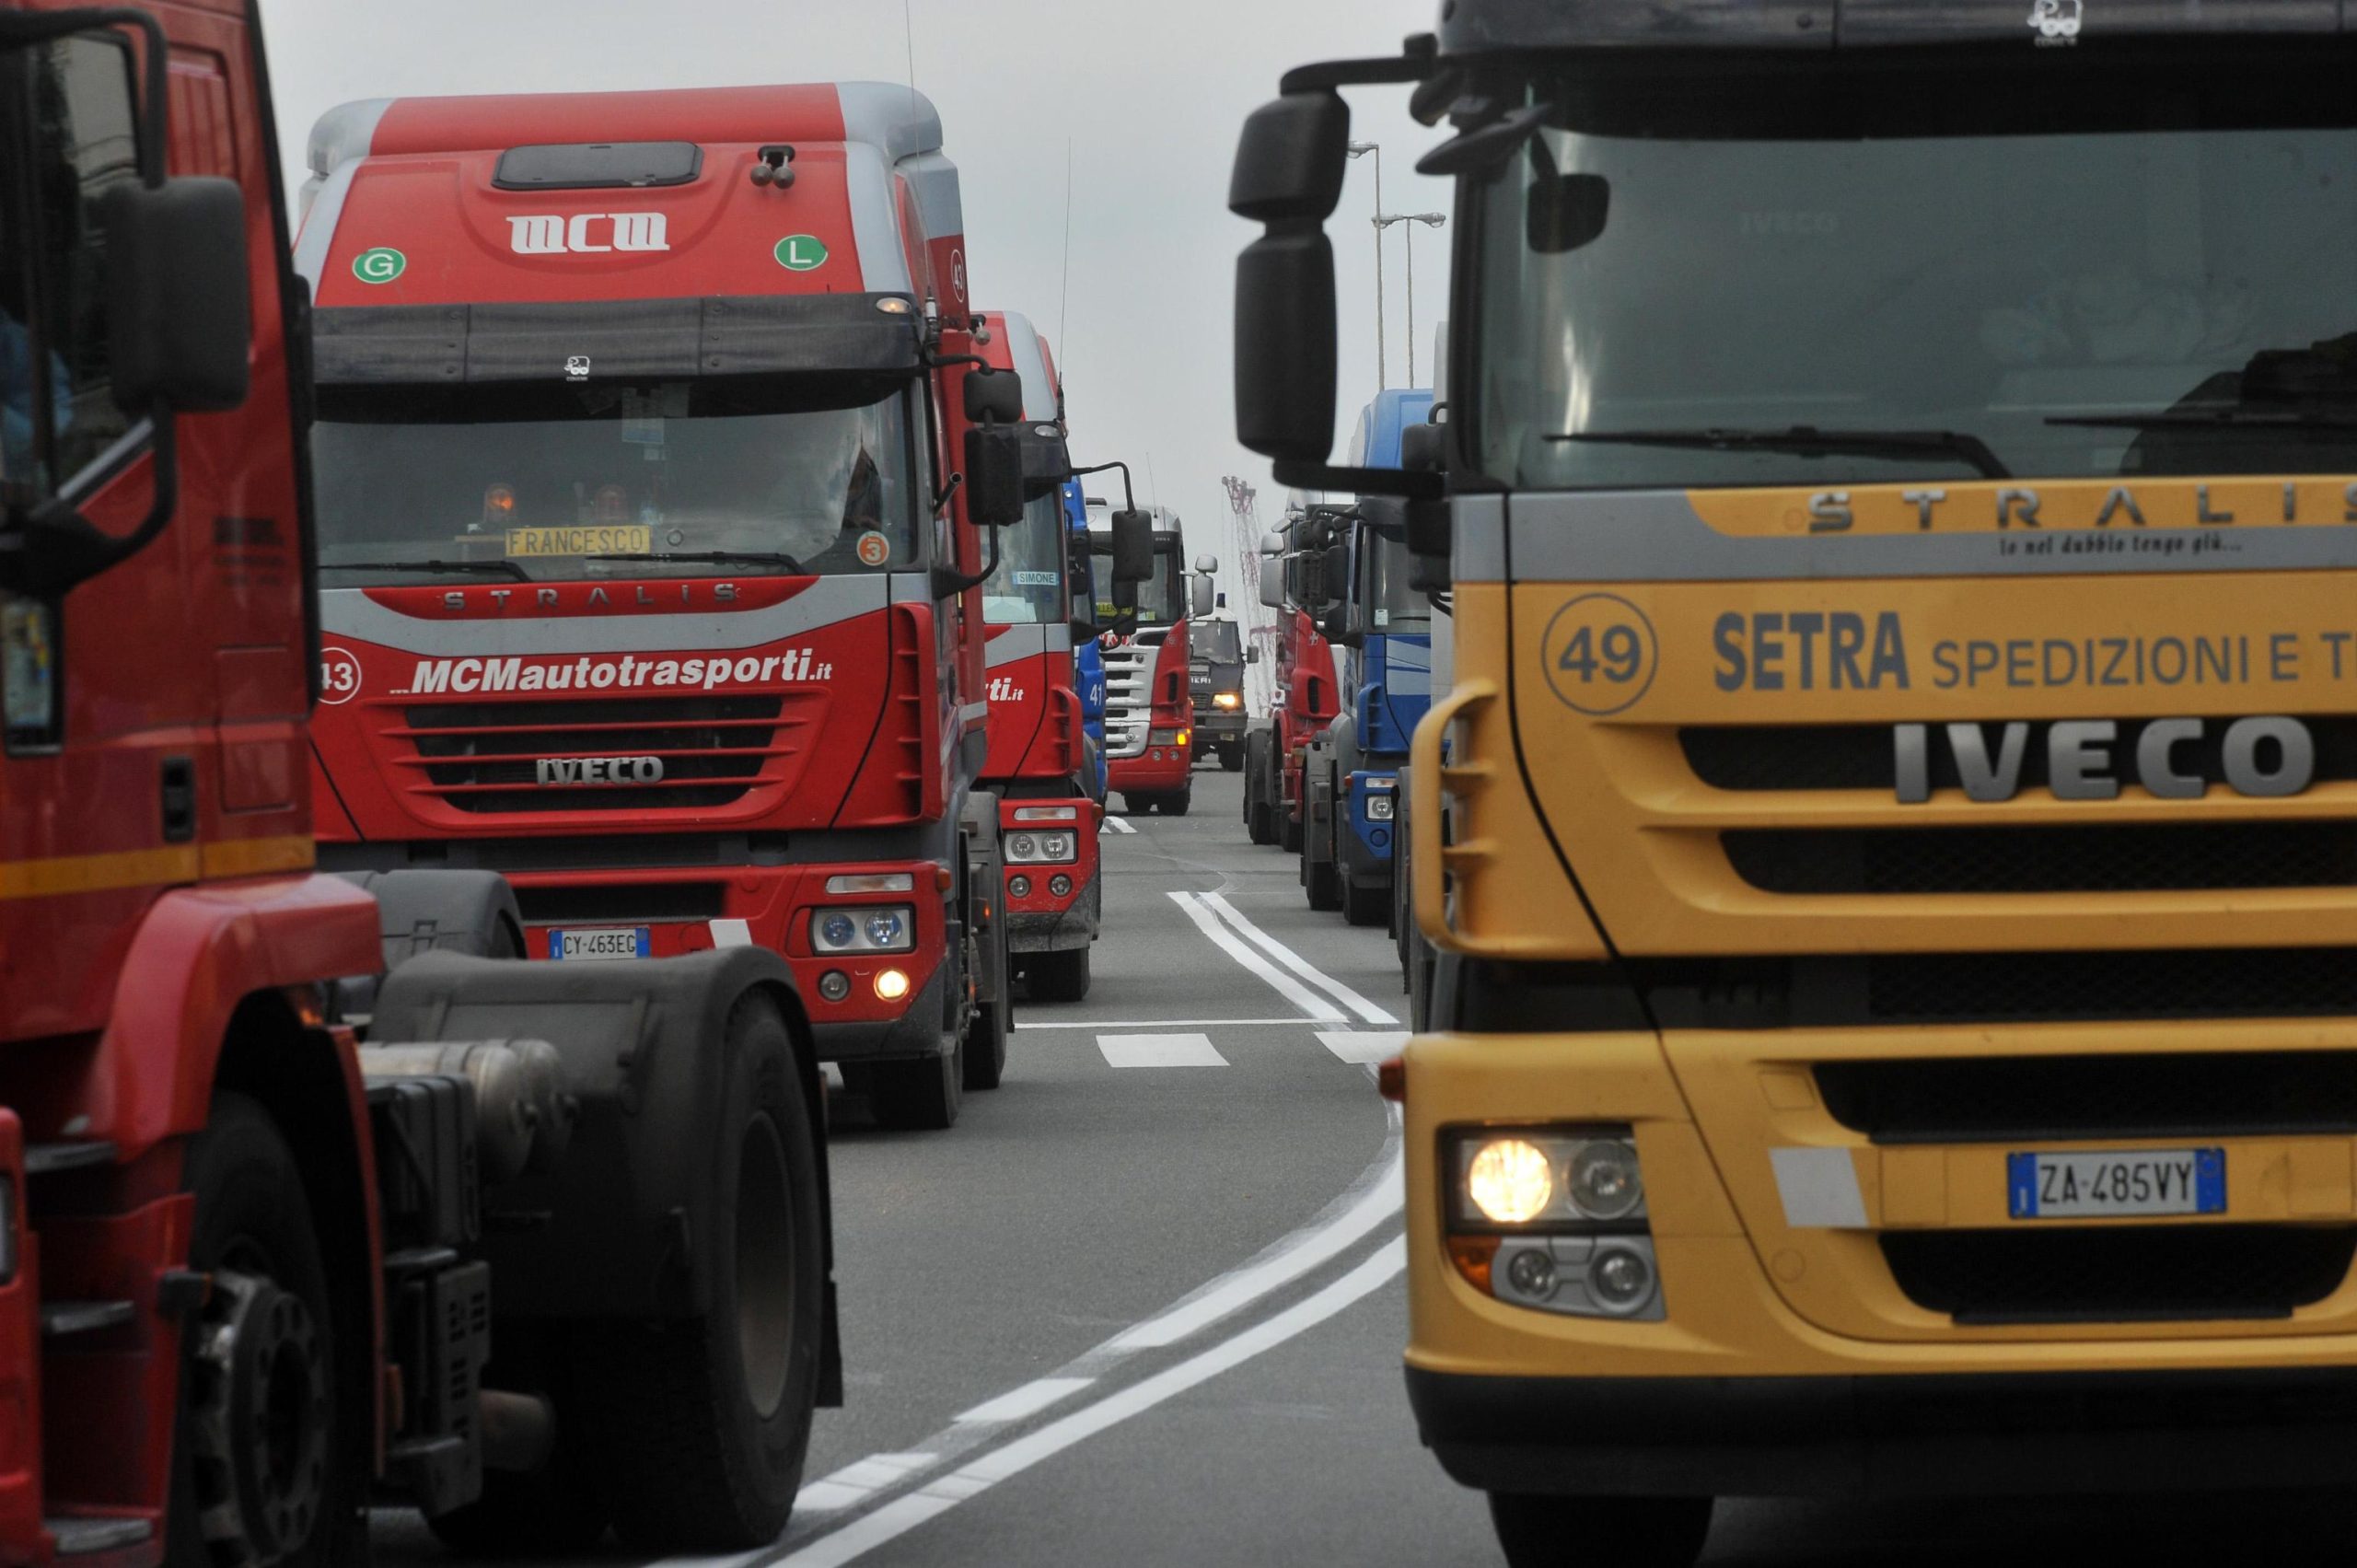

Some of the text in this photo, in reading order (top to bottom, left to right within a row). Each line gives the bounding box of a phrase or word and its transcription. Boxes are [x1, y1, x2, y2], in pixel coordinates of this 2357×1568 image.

[790, 240, 812, 263] L
[363, 253, 393, 277] G
[1808, 482, 2357, 532] STRALI
[508, 528, 644, 553] FRANCESCO
[865, 542, 881, 561] 3
[1018, 573, 1055, 584] SIMONE
[444, 583, 735, 610] STRALIS
[1558, 624, 1643, 684] 49
[1713, 611, 2357, 692] SETRA SPEDIZIONI E T
[984, 678, 1024, 701] ti.it
[1089, 684, 1103, 706] 41
[536, 756, 664, 785] IVECO
[1893, 715, 2316, 803] IVECO
